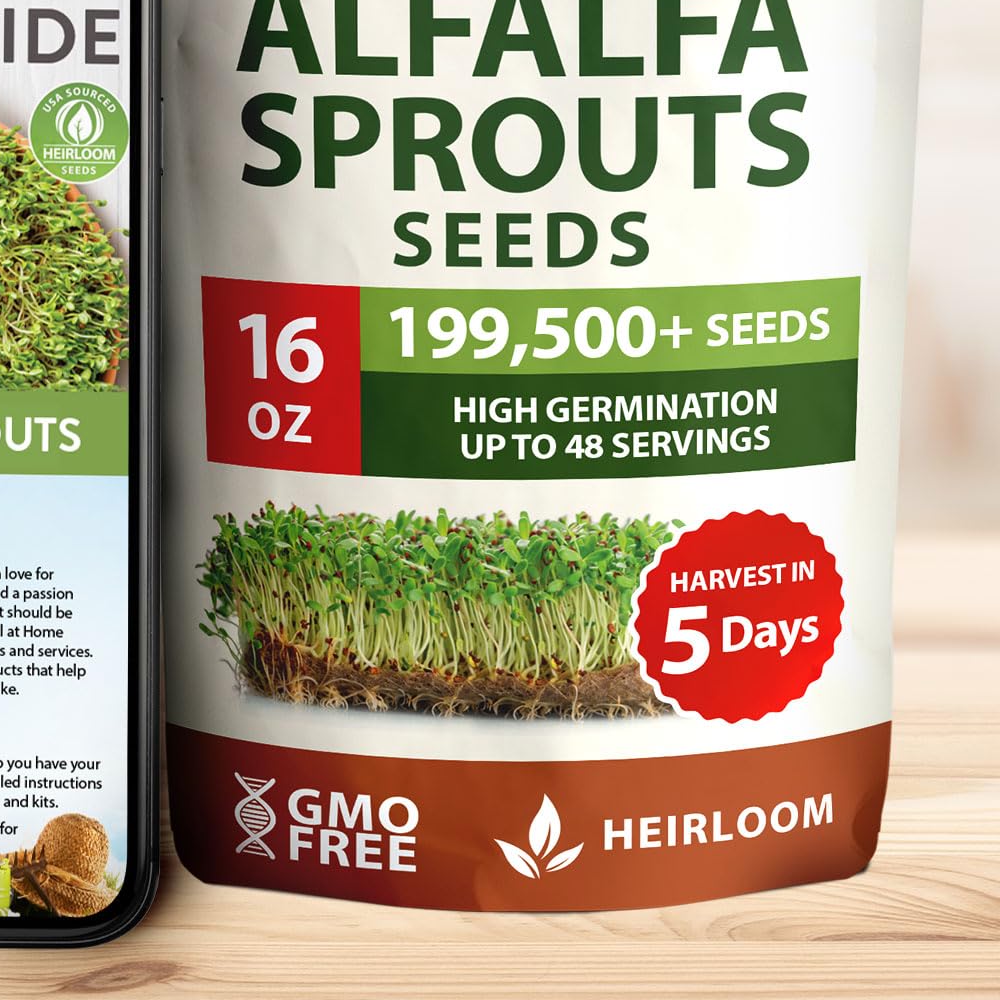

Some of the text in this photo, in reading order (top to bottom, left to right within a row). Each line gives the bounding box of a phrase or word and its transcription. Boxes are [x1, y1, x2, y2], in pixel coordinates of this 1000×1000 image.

[43, 87, 116, 112] USA SOURCED
[43, 148, 116, 160] HEIRLOOM
[241, 92, 809, 193] SPROUTS
[61, 166, 96, 174] SEEDS
[394, 212, 649, 267] SEEDS
[239, 314, 323, 383] 16
[390, 306, 829, 366] 199,500+ SEEDS
[455, 389, 777, 423] HIGH GERMINATION
[248, 402, 311, 443] OZ
[462, 425, 770, 459] UP TO 48 SERVINGS
[4, 566, 33, 580] love
[35, 567, 55, 580] for
[671, 560, 814, 592] HARVEST IN
[12, 590, 20, 599] a
[23, 587, 74, 602] passion
[7, 605, 52, 618] should
[55, 605, 73, 619] be
[6, 627, 21, 637] at
[23, 625, 64, 638] Home
[662, 606, 818, 674] 5 Days
[9, 644, 35, 656] and
[37, 645, 93, 657] services.
[6, 760, 32, 772] you
[35, 756, 68, 769] have
[70, 761, 101, 773] your
[3, 794, 29, 807] and
[32, 795, 59, 808] kits.
[289, 789, 418, 835] GMO
[0, 821, 19, 835] for
[605, 794, 832, 850] HEIRLOOM
[290, 825, 416, 872] FREE
